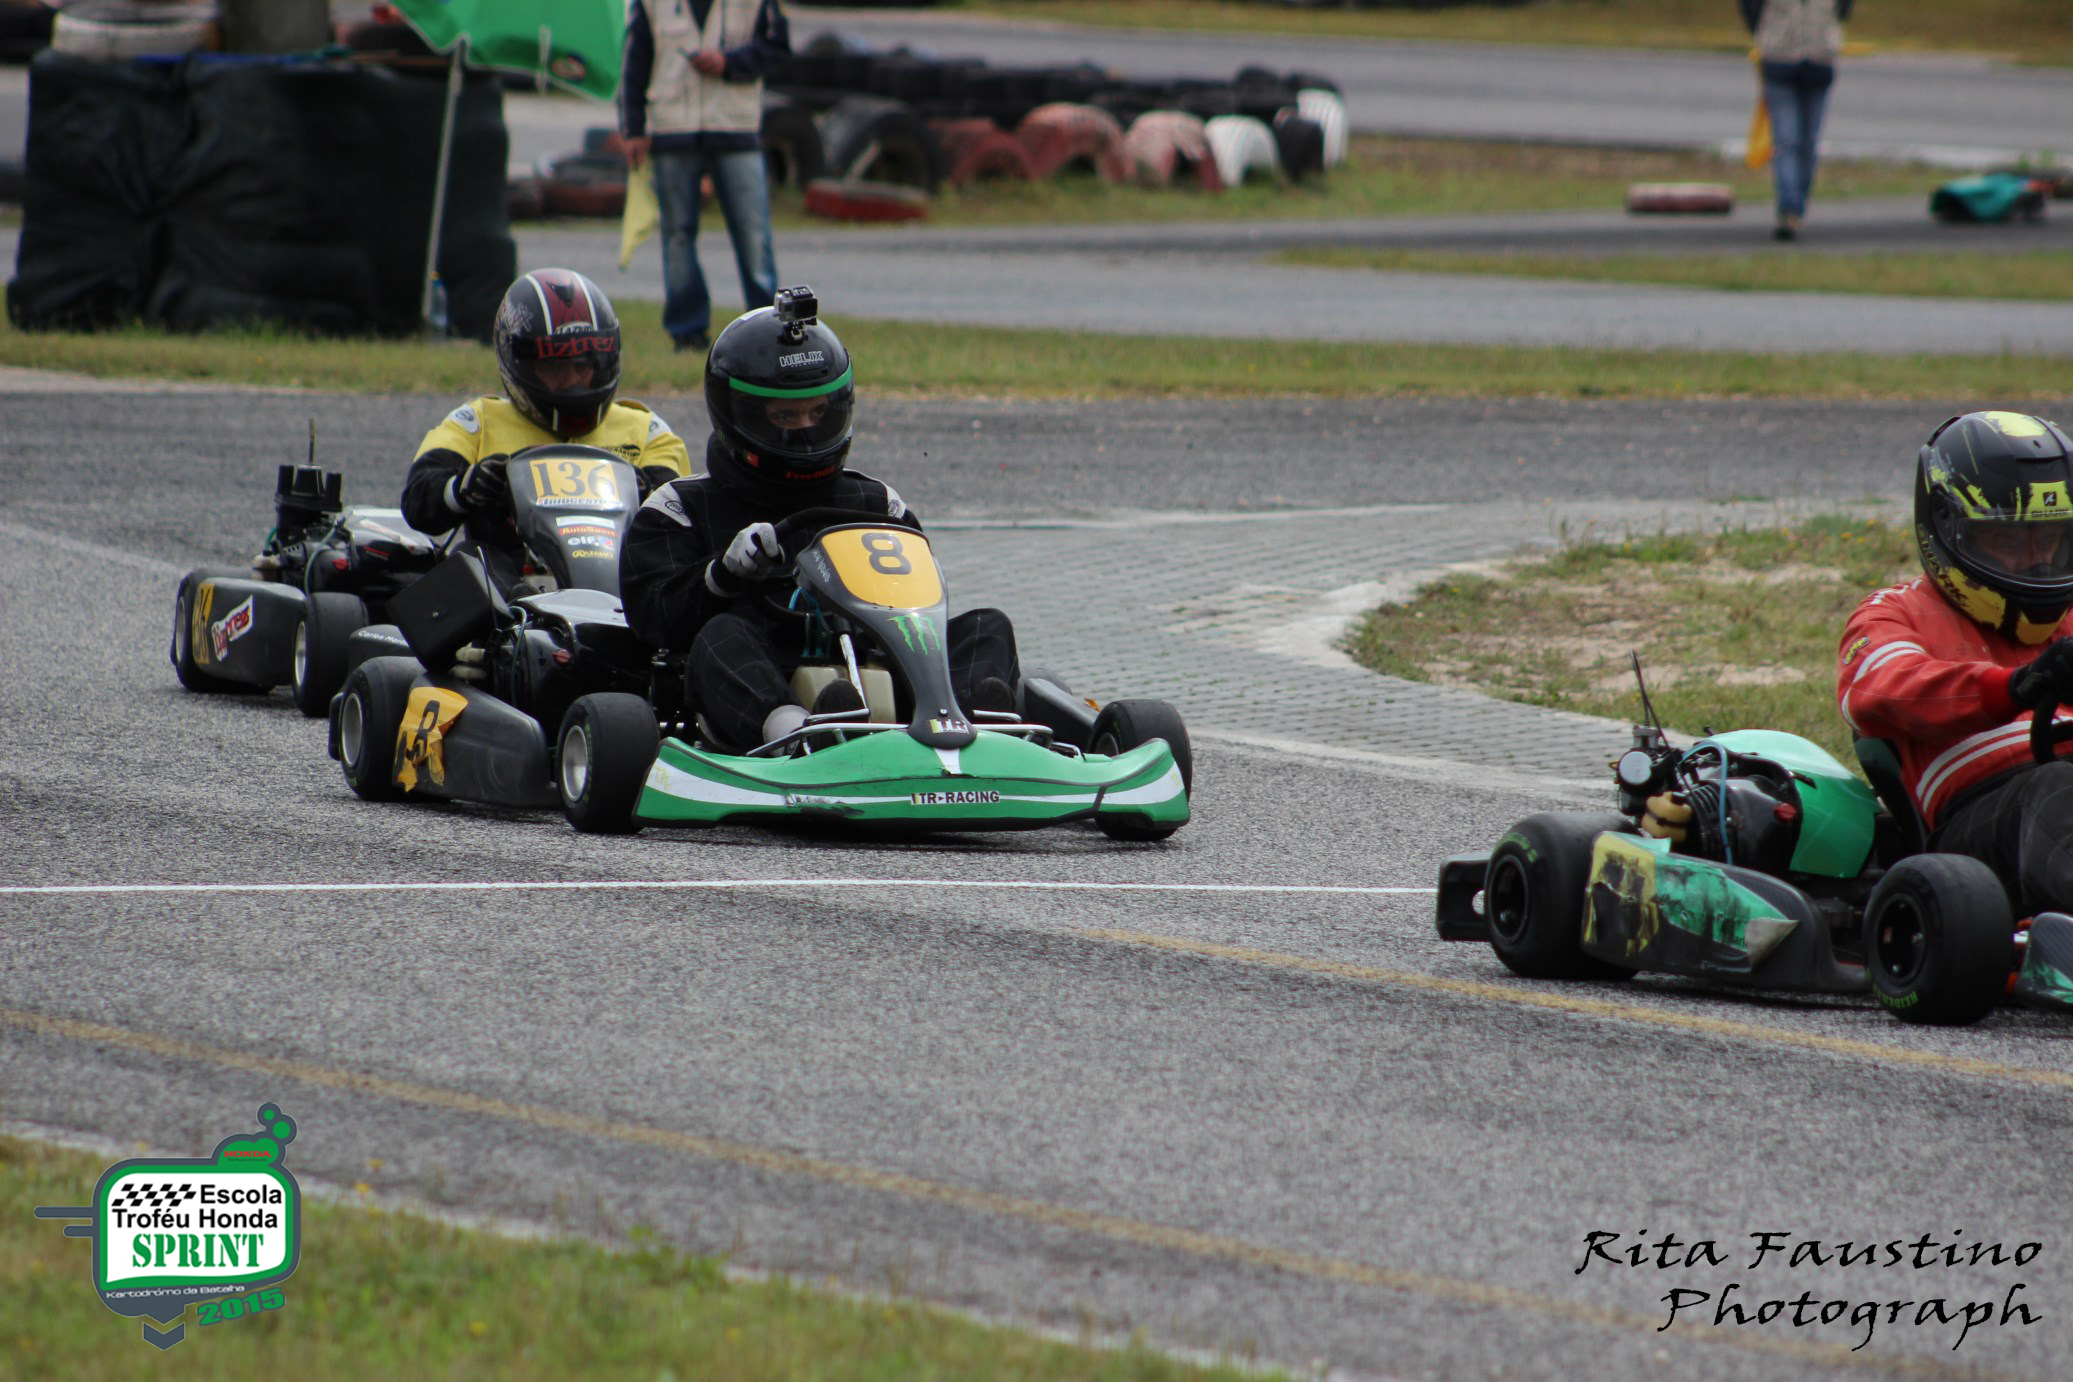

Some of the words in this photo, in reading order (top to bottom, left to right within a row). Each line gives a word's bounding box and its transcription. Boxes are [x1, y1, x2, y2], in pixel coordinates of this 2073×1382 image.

[779, 350, 825, 368] HELIX
[533, 462, 616, 498] 136
[861, 532, 913, 576] 8
